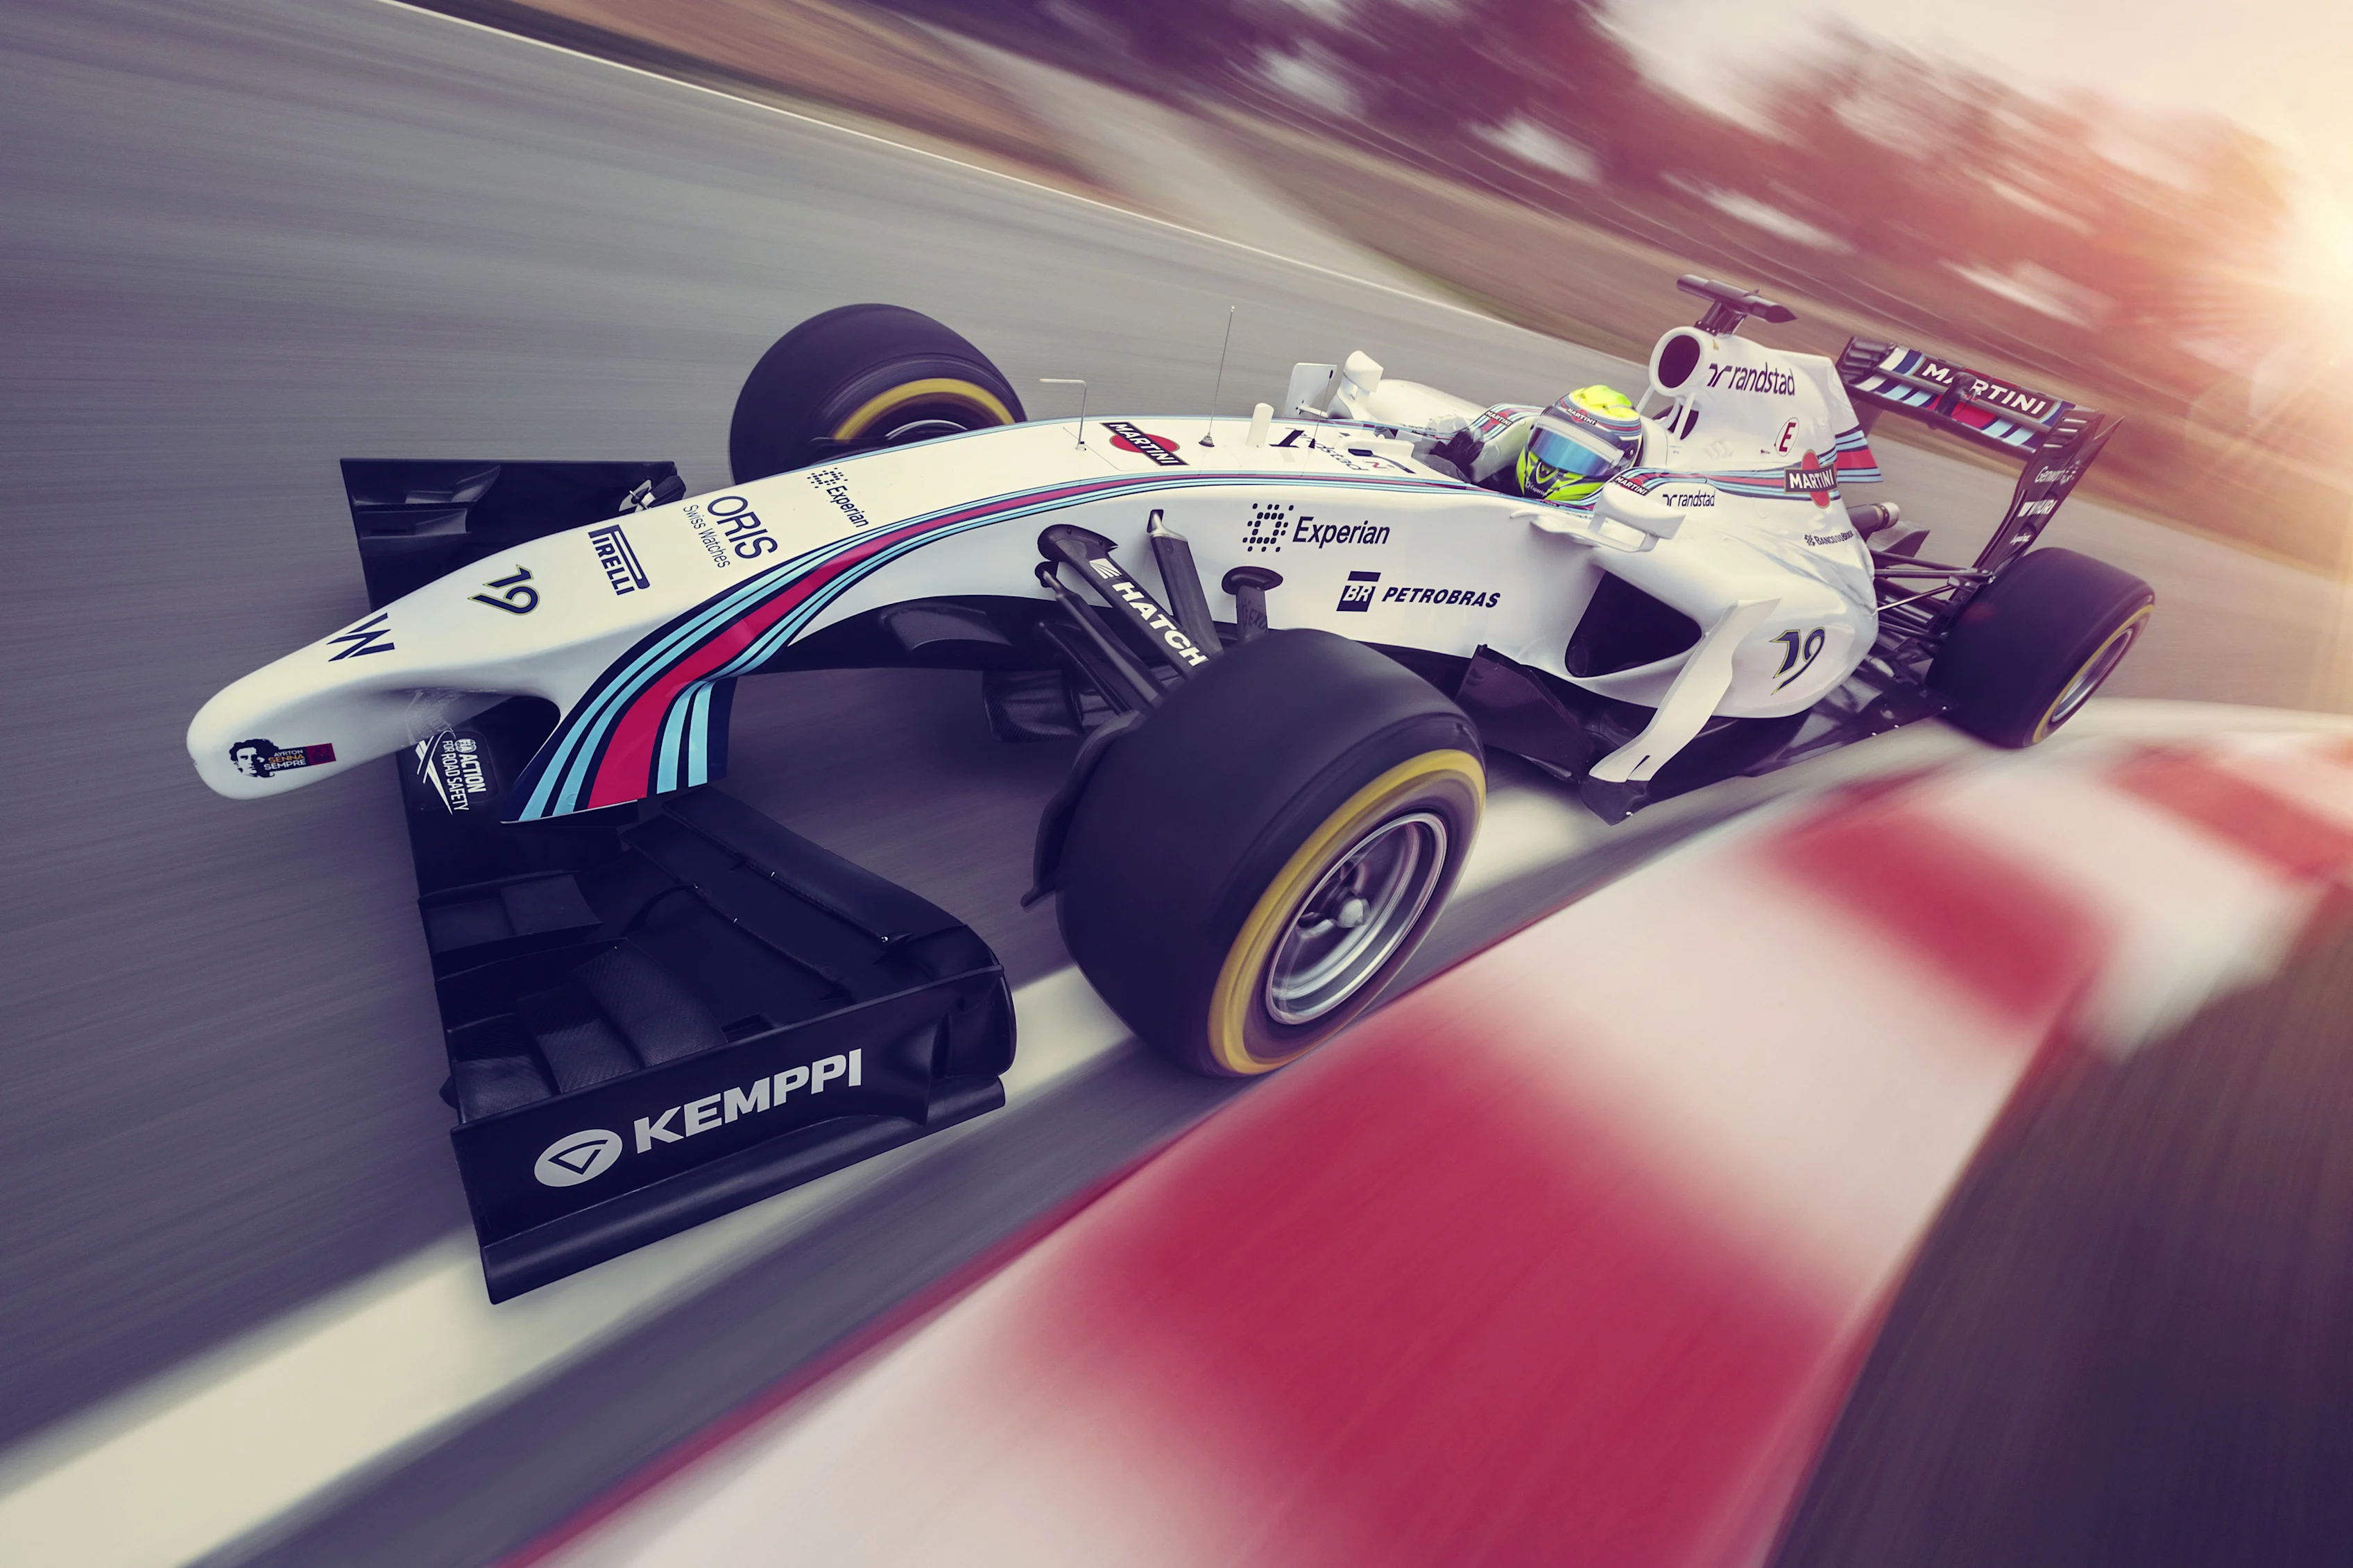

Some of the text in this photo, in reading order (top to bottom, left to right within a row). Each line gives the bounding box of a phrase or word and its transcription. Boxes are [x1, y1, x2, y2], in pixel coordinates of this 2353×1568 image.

[1728, 361, 1795, 395] randstad
[1486, 411, 1512, 426] MARTINI
[1567, 408, 1596, 424] MARTINI
[1109, 424, 1179, 463] MARTINI
[1778, 422, 1797, 452] E
[1615, 476, 1648, 496] MARTINI
[1789, 469, 1834, 489] MARTINI
[825, 485, 869, 528] Experian
[1677, 490, 1716, 507] randstad
[683, 505, 730, 568] Swiss Watches
[708, 496, 778, 559] ORIS
[1292, 516, 1390, 549] Experian
[588, 524, 651, 596] PIRELLI
[468, 564, 540, 616] 19
[1342, 585, 1500, 608] BR PETROBRAS
[1111, 582, 1209, 666] HATCH
[1769, 626, 1826, 696] 19
[264, 759, 306, 770] SEMPRE
[268, 754, 305, 764] SENNA
[274, 749, 303, 757] AYRTON
[440, 740, 470, 811] FOR ROAD SAFETY
[459, 754, 486, 793] ACTION
[634, 1048, 862, 1153] KEMPPI
